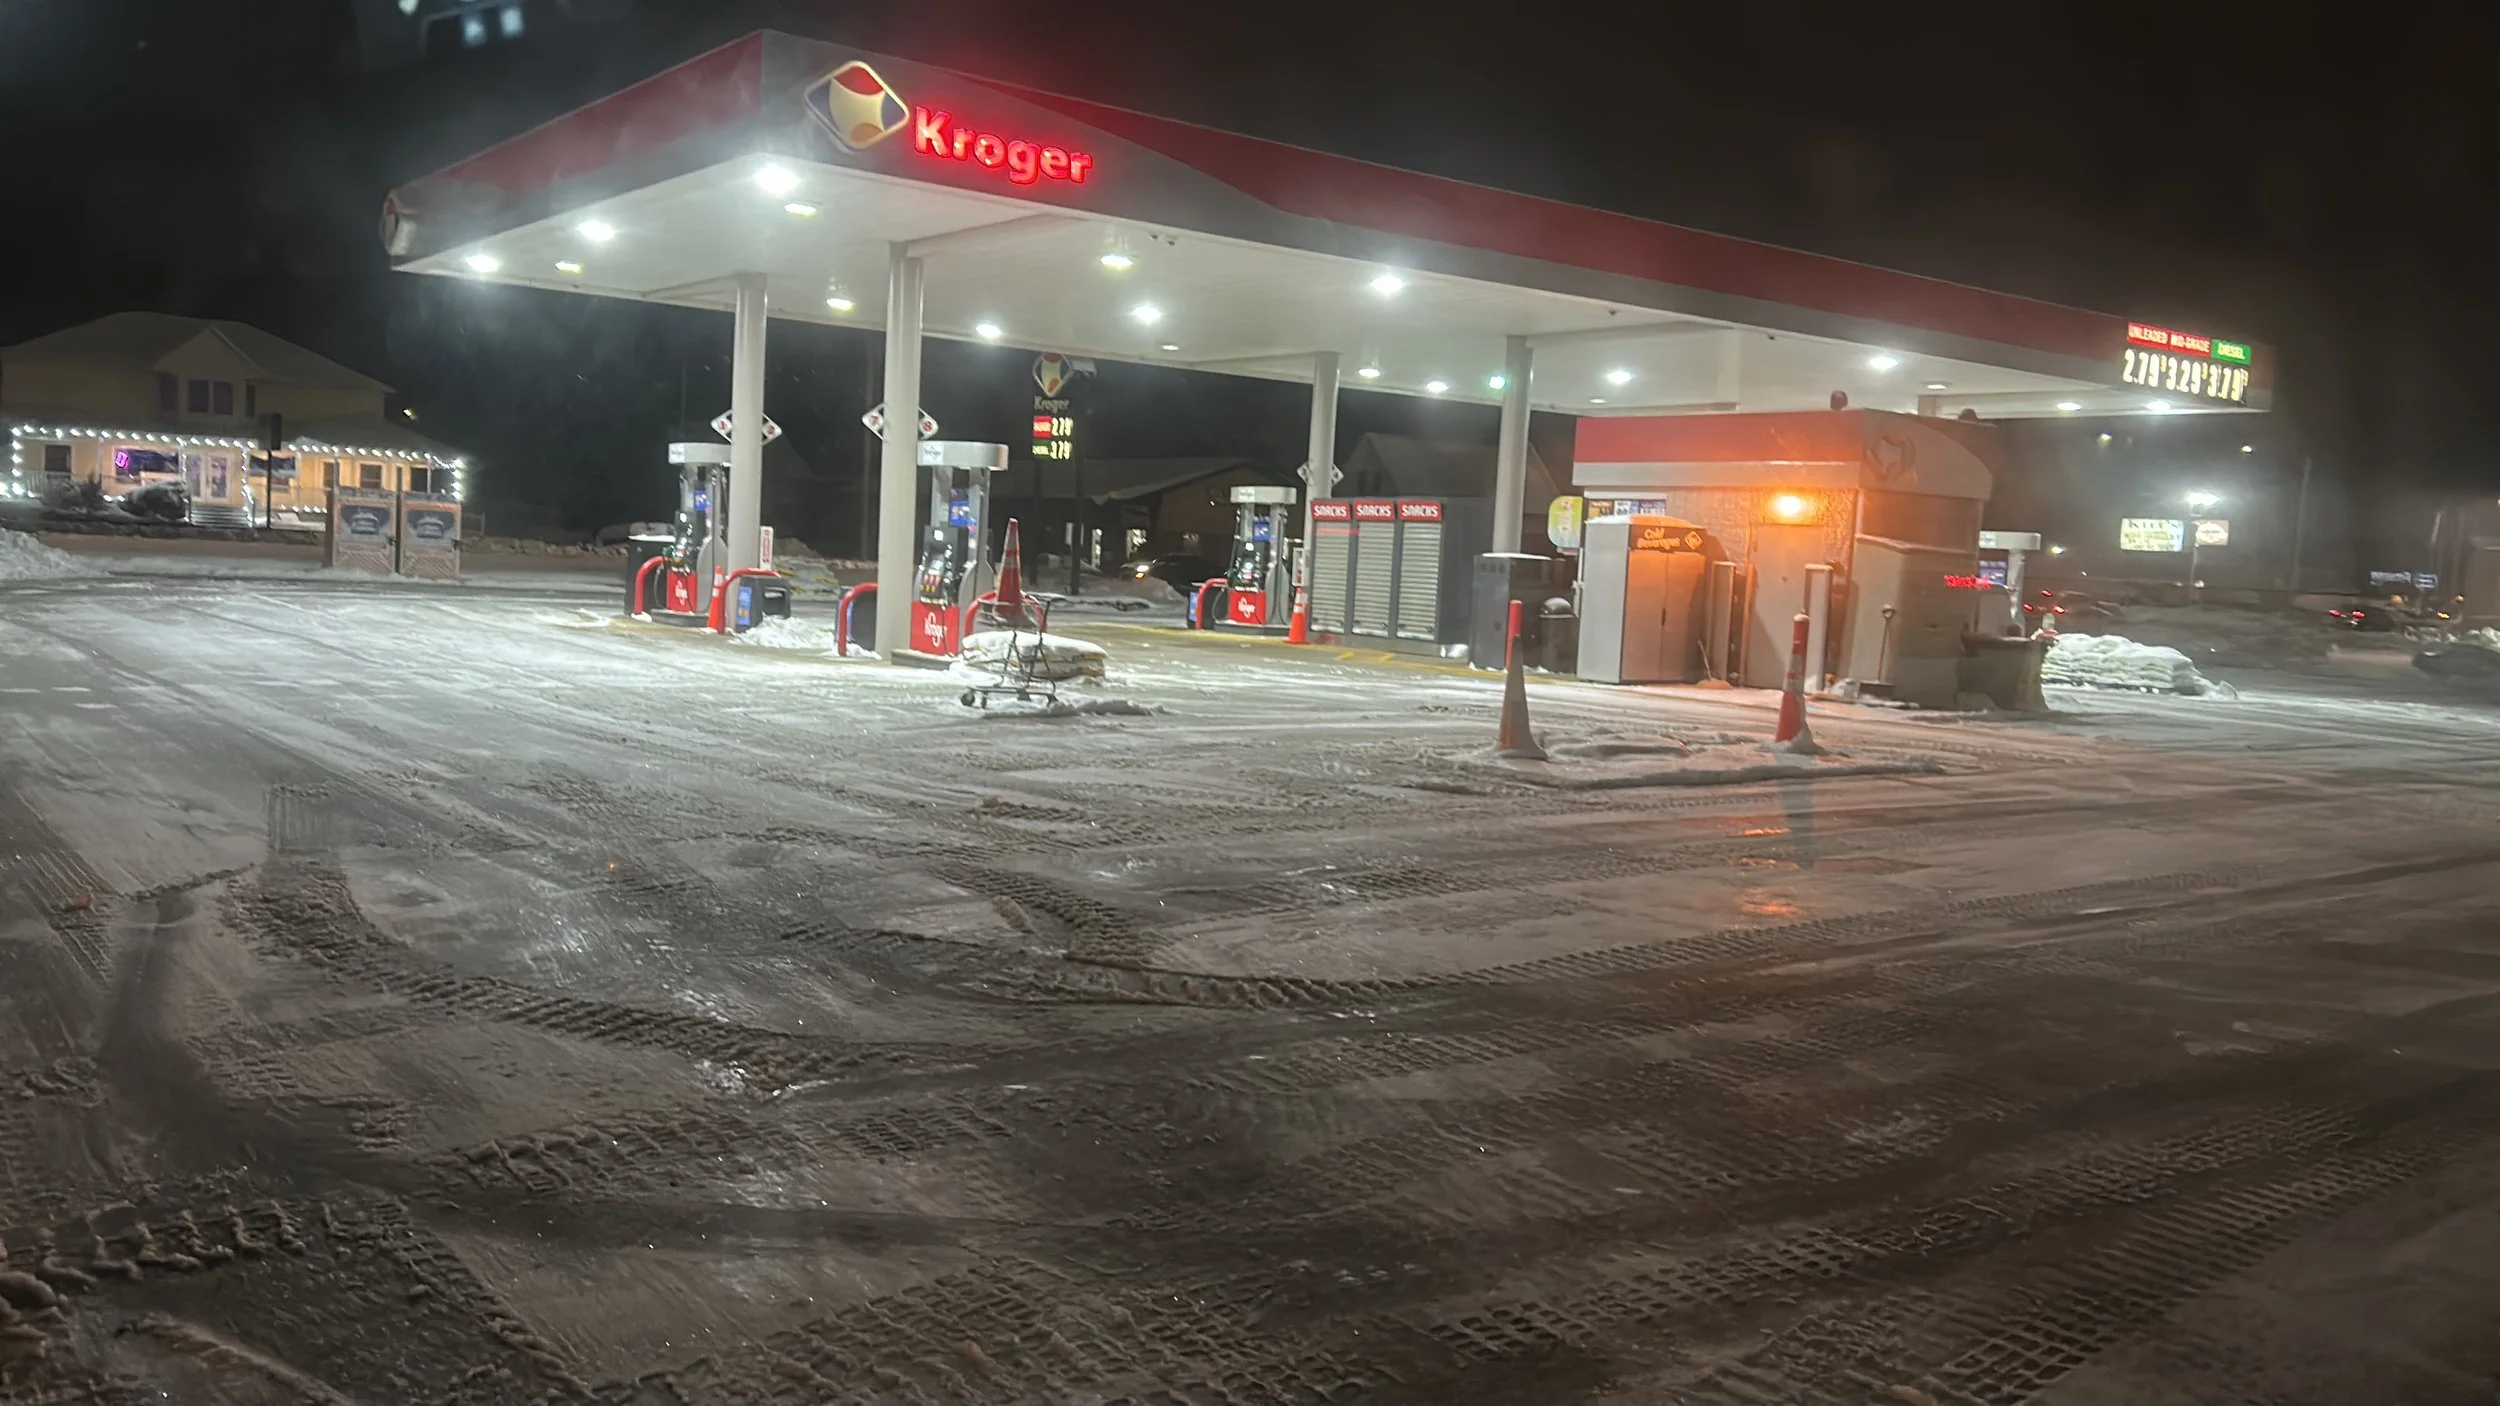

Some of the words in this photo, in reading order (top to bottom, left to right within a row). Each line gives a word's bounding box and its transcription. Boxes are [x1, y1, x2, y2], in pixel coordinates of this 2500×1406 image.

[914, 106, 1093, 184] Kroger
[2127, 325, 2168, 345] UNLEADED
[2217, 342, 2246, 360] DIESEL
[1034, 395, 1070, 413] Kroger
[1313, 504, 1347, 518] SNACKS
[1356, 504, 1392, 518] SNACKS
[1401, 504, 1438, 518] SNACKS
